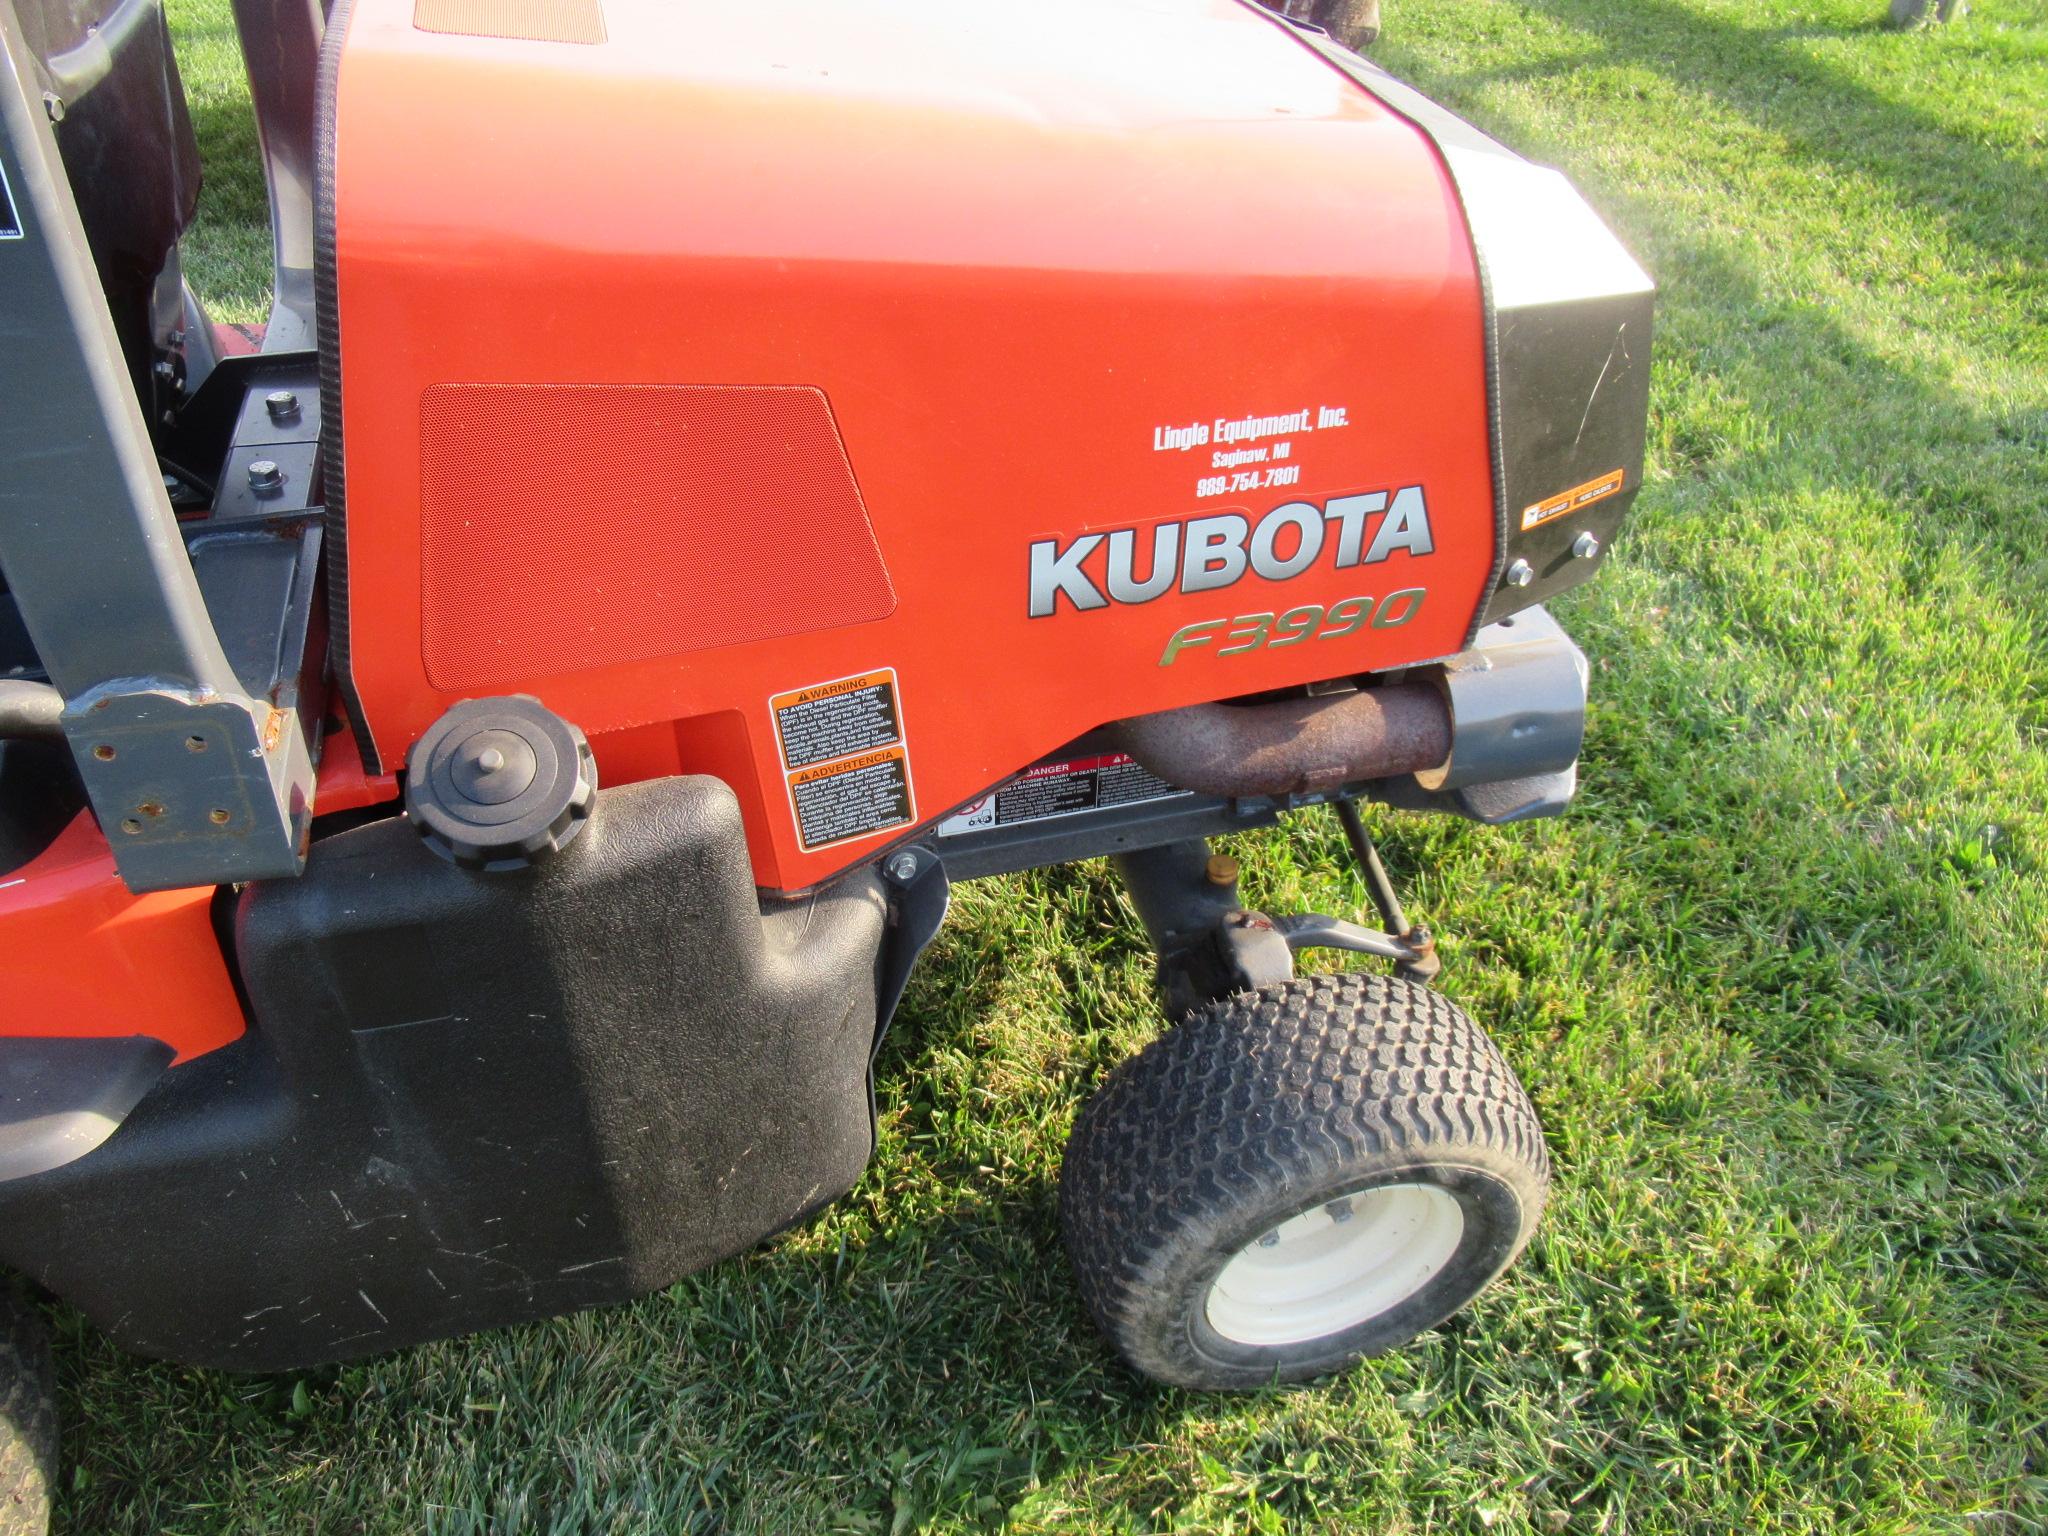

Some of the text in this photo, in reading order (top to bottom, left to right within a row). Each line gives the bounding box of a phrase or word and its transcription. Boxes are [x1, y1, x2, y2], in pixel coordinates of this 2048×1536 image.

[1154, 406, 1349, 451] Lingle Equipment, Inc.
[1212, 442, 1290, 469] Saginaw, MI
[1196, 465, 1300, 498] 989-754-7801
[1028, 485, 1435, 619] KUBOTA
[1159, 587, 1426, 667] F3990
[790, 702, 812, 712] AVOID
[814, 692, 853, 706] PERSONAL
[854, 685, 882, 696] INJURY:
[810, 677, 867, 698] WARNING
[811, 750, 893, 778] ADVERTENCIA
